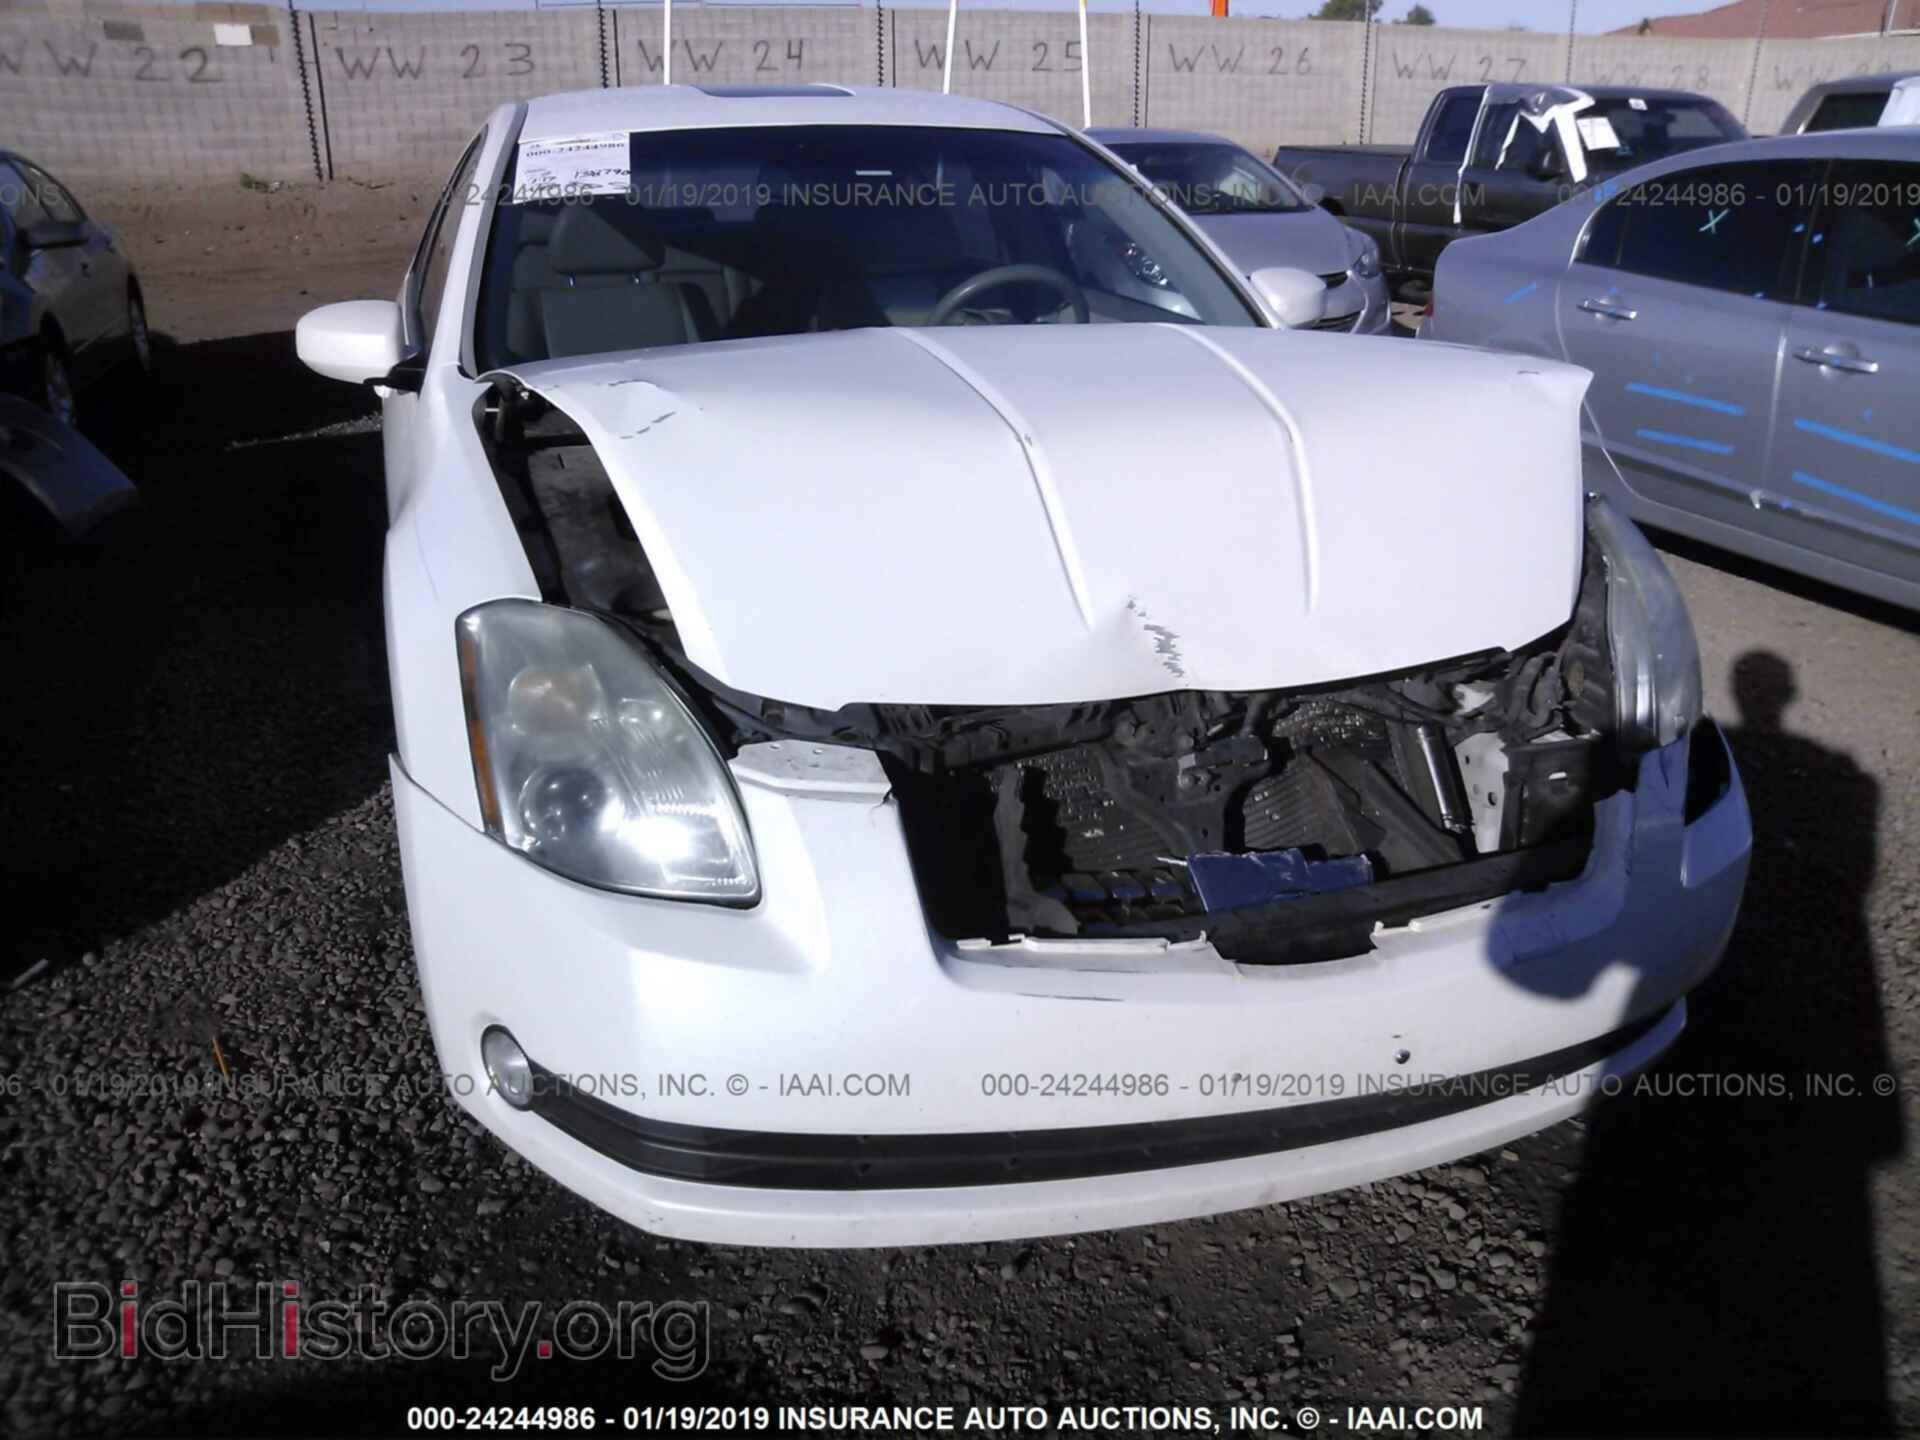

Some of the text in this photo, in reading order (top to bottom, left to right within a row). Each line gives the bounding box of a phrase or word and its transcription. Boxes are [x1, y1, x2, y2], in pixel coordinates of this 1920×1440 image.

[134, 46, 224, 82] 22
[334, 42, 535, 80] WW 23
[637, 38, 804, 72] WW 24
[1031, 41, 1083, 72] 25
[1168, 42, 1313, 76] WW 26
[1391, 48, 1527, 84] WW 27
